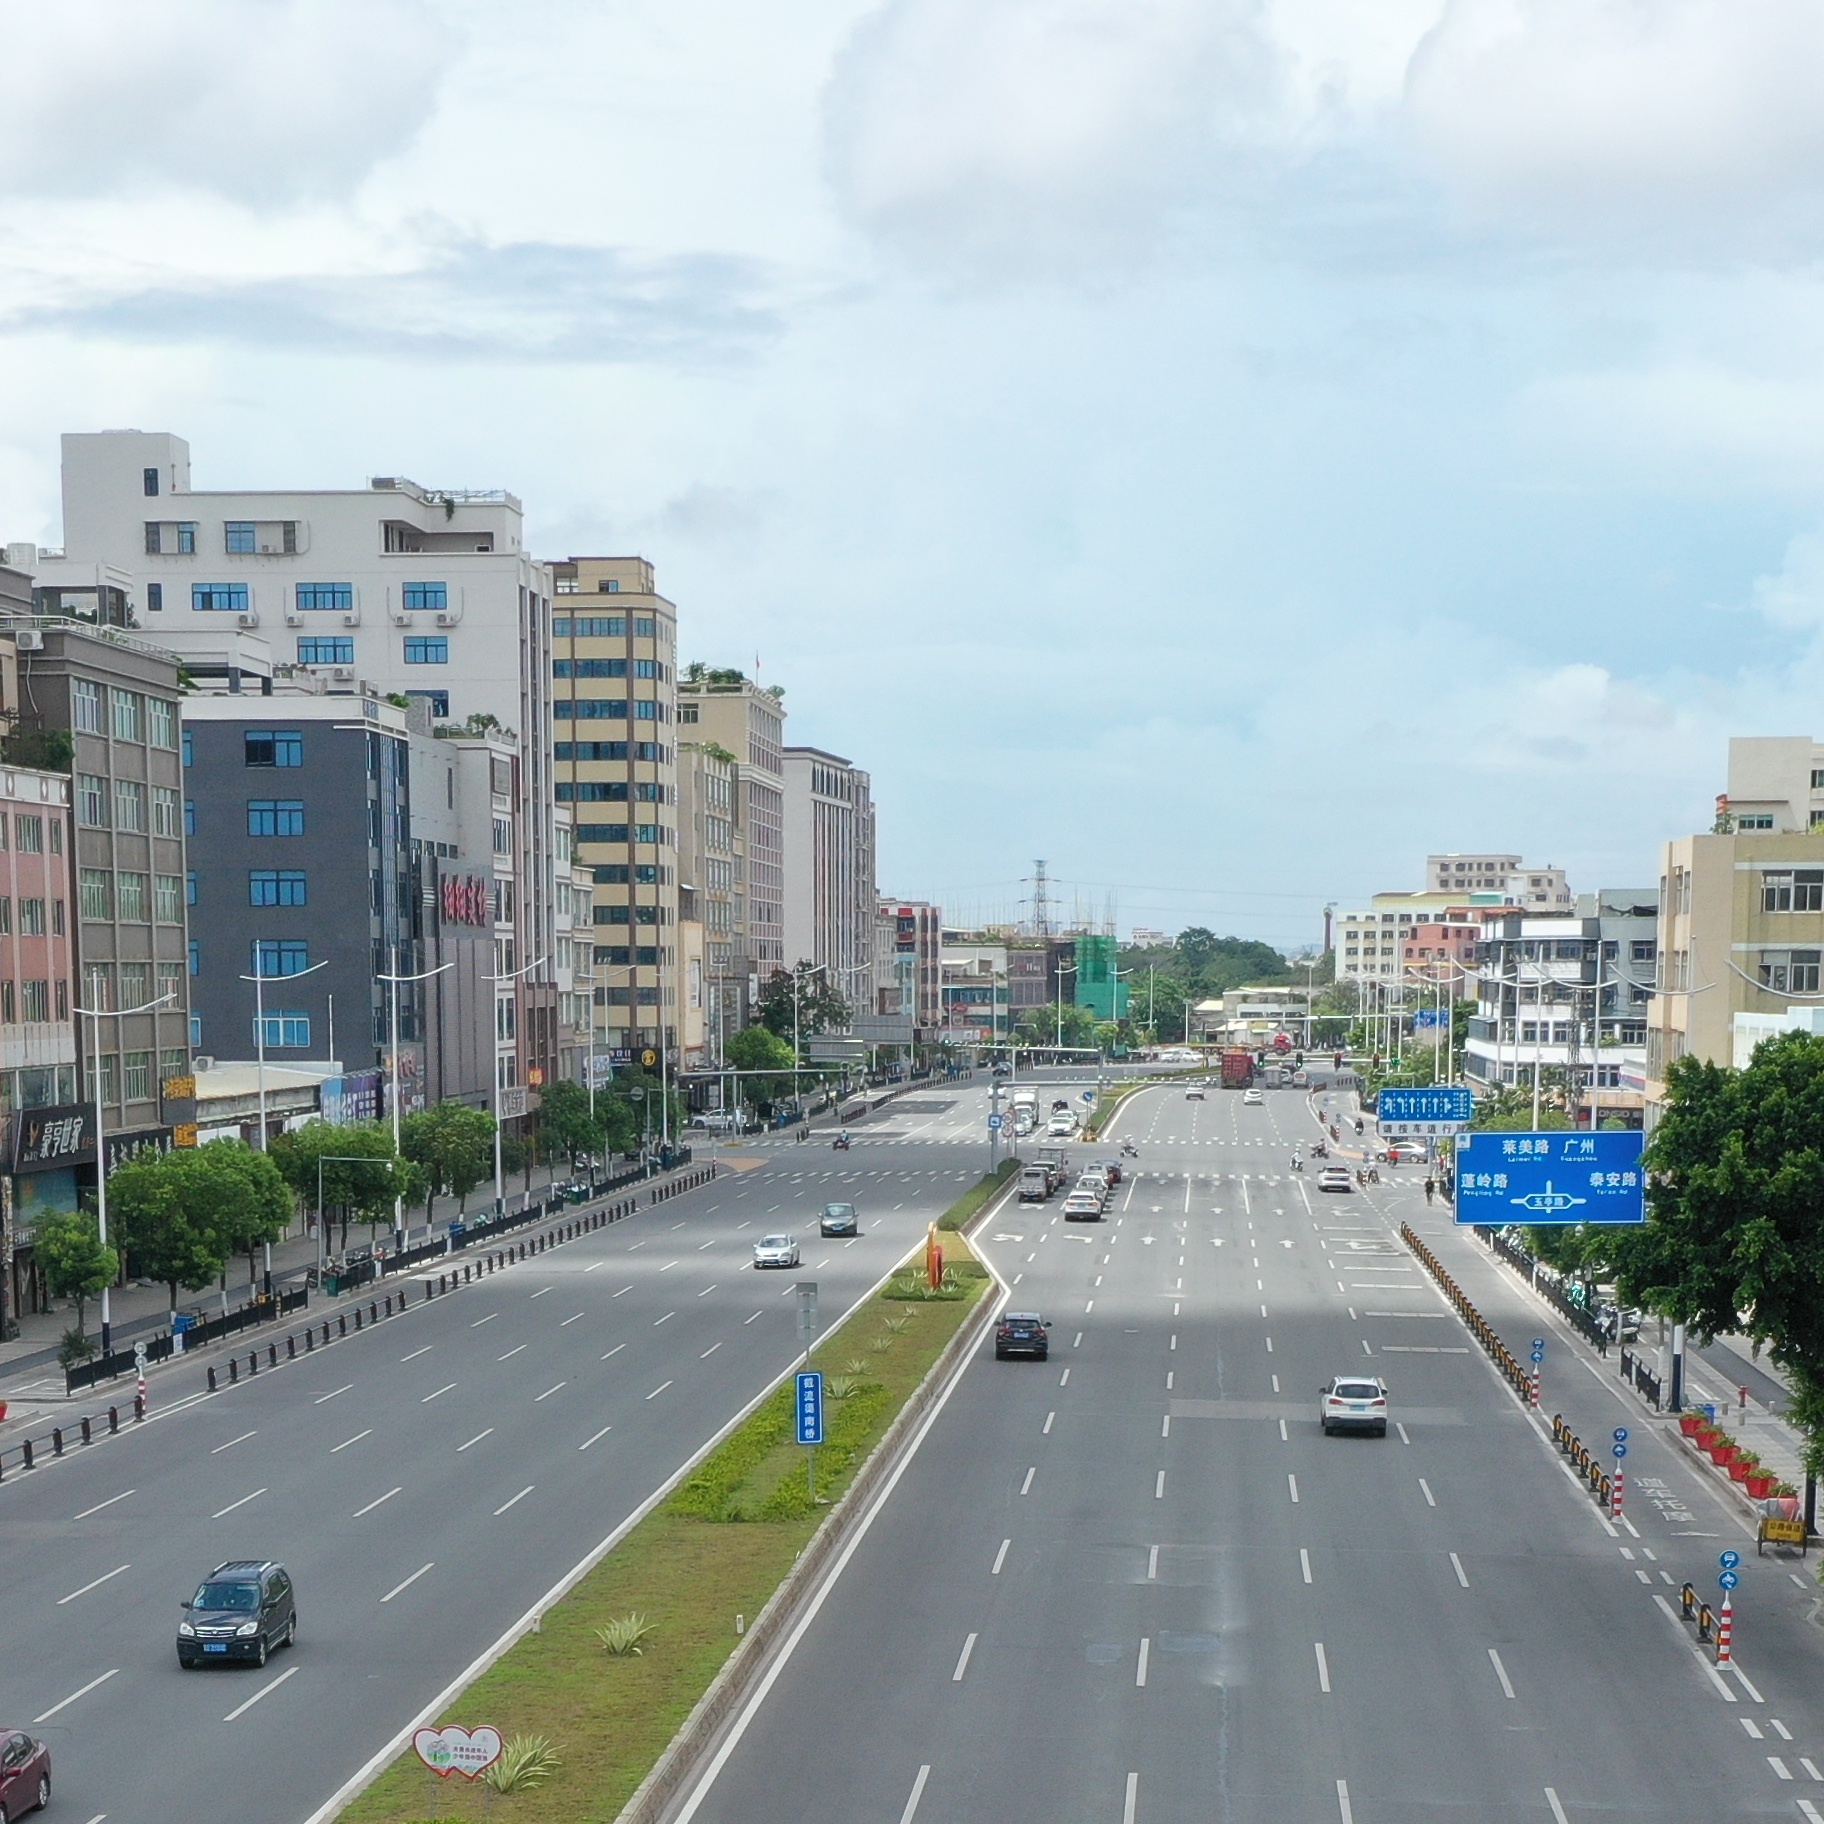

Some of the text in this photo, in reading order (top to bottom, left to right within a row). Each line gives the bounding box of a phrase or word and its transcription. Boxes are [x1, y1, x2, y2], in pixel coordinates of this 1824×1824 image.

[1502, 1139, 1595, 1155] 莱美路 广州
